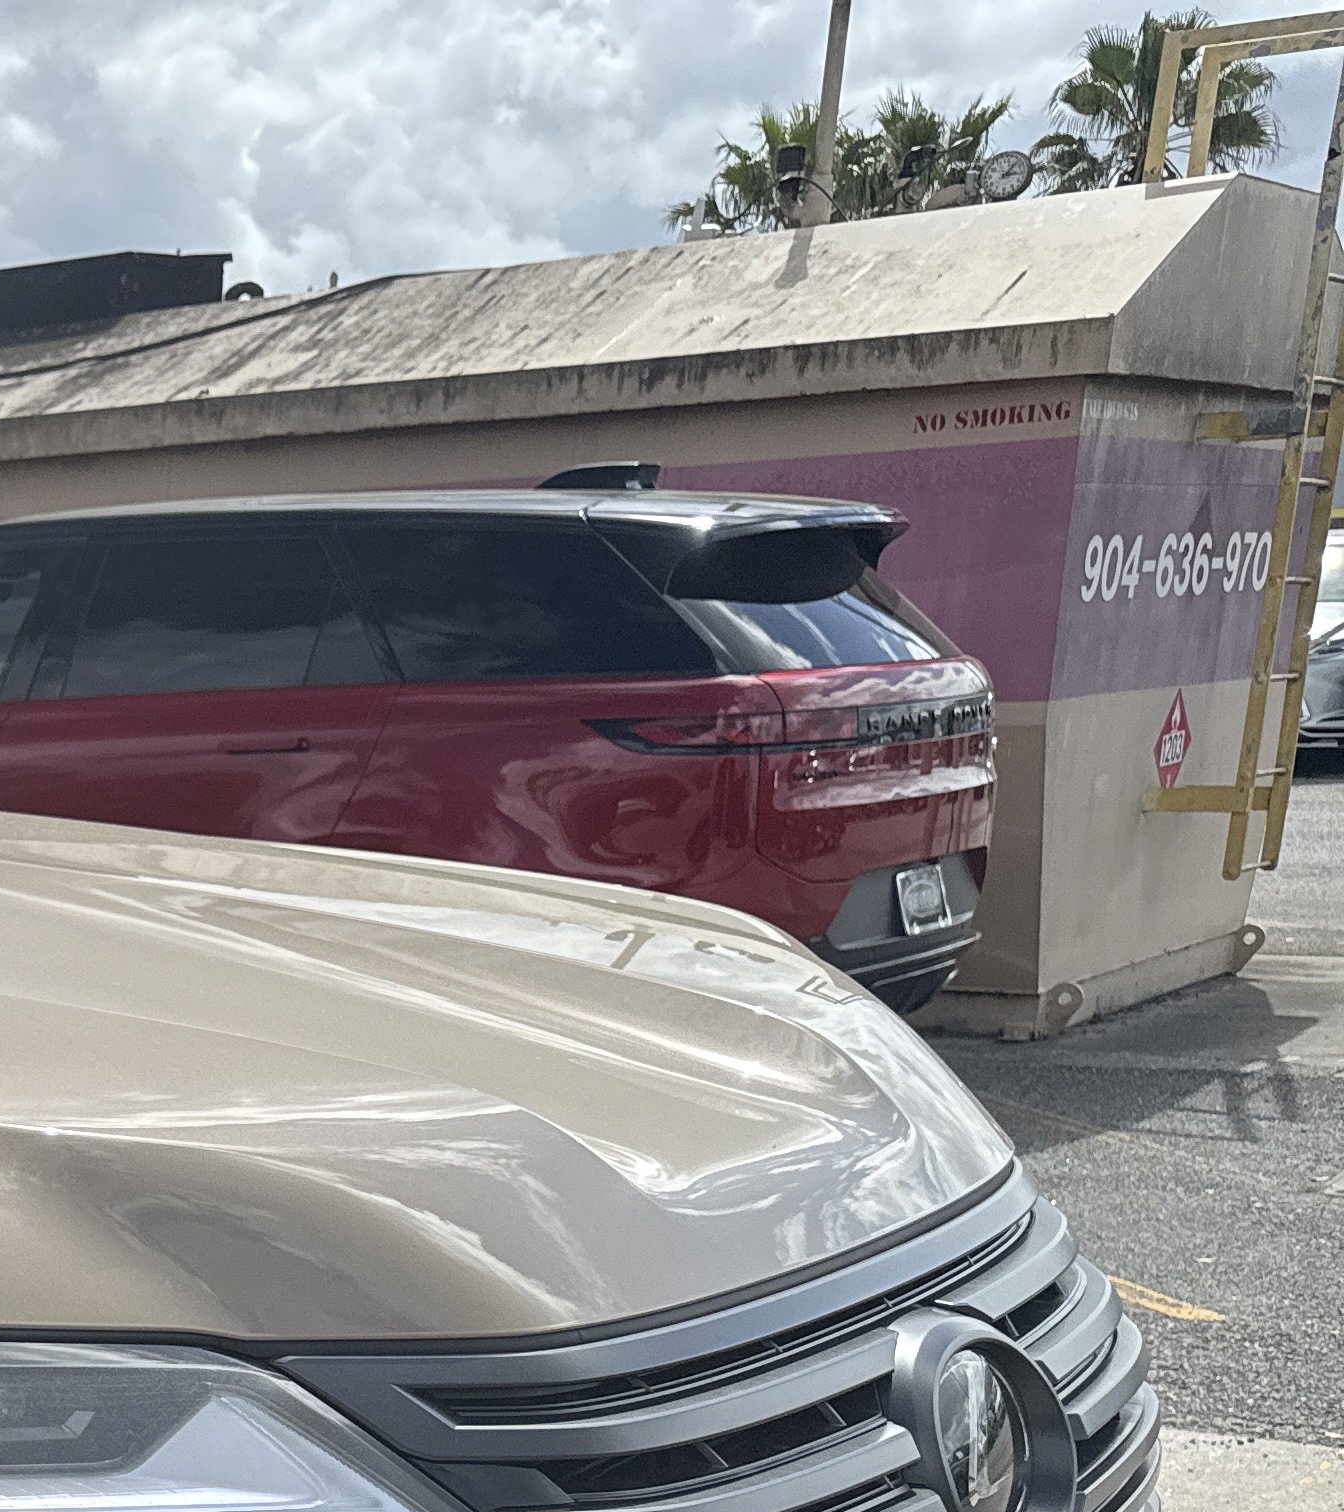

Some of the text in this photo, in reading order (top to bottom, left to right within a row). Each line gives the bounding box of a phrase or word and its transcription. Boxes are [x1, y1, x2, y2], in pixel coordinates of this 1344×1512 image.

[913, 401, 1072, 434] NO SMOKING
[1080, 530, 1273, 603] 904-636-970
[1161, 732, 1184, 764] 1203
